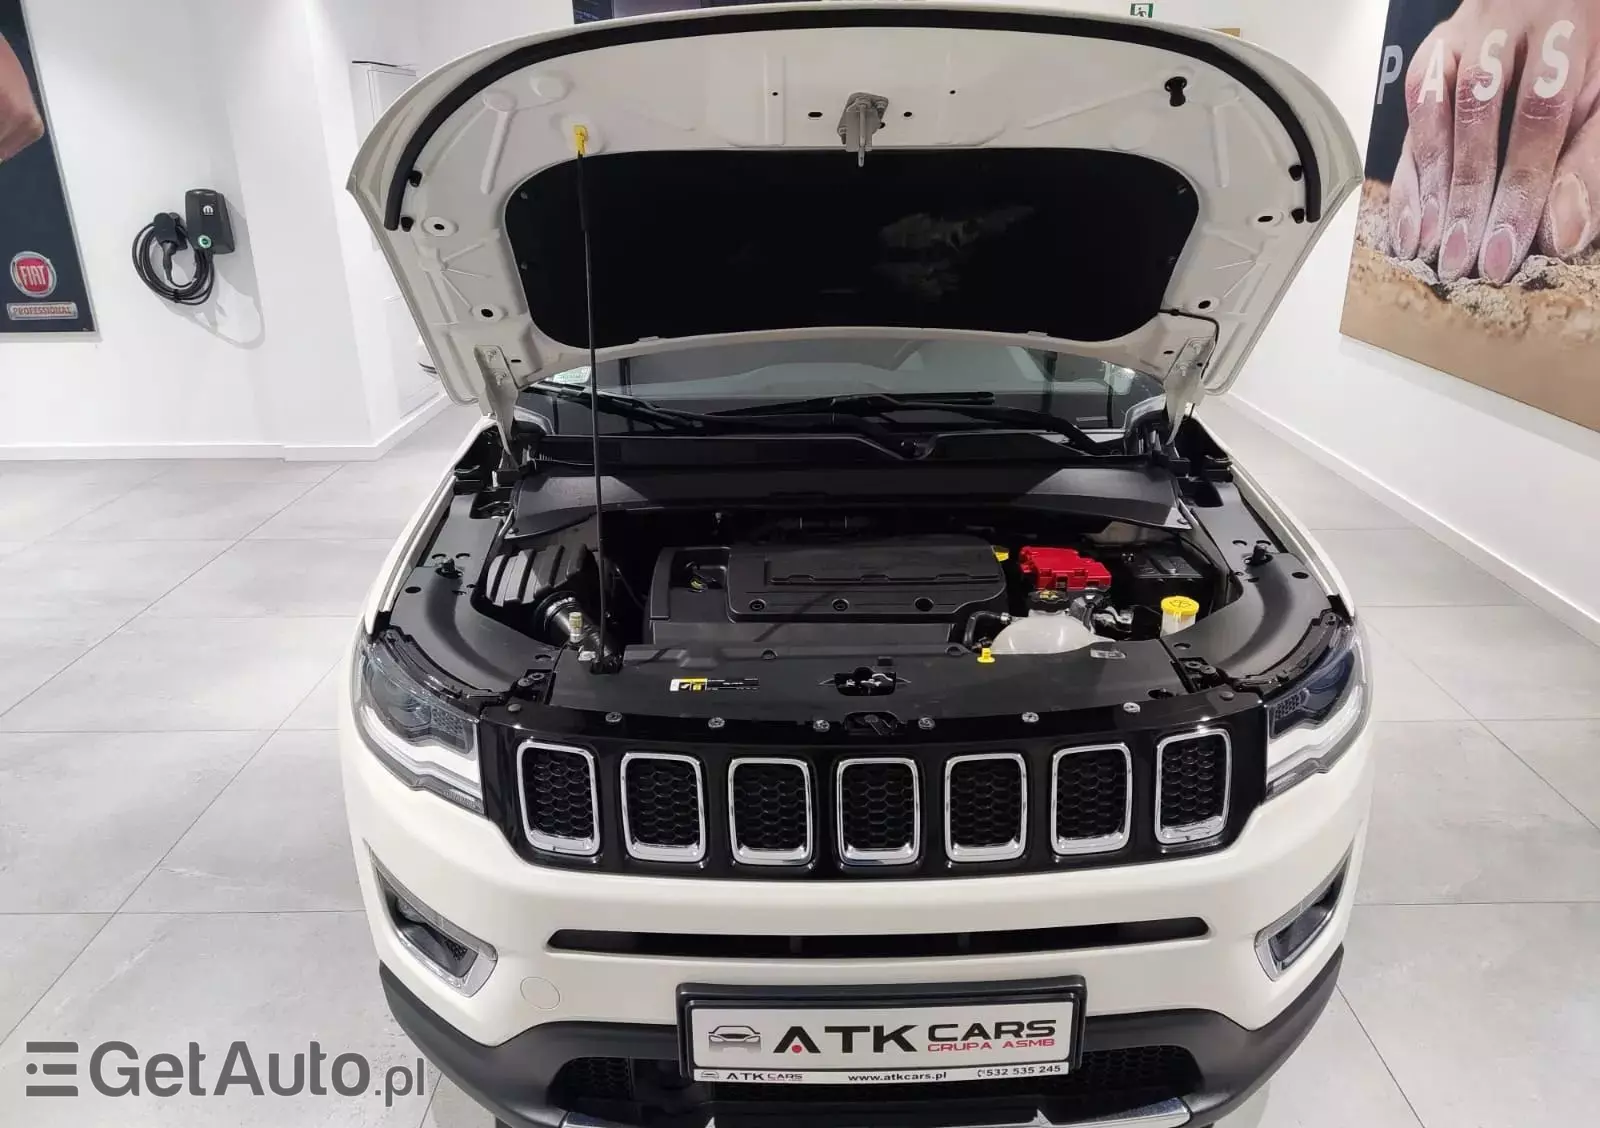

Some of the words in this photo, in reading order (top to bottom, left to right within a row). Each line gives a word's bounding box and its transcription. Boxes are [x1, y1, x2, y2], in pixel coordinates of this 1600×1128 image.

[19, 265, 47, 287] FIAT
[13, 306, 73, 316] PROFESSIONAL
[772, 1024, 919, 1054] ATK
[927, 1019, 1057, 1043] CARS
[927, 1041, 993, 1053] GRUPA
[1001, 1038, 1056, 1050] ASMB
[726, 1072, 765, 1081] ATK
[767, 1073, 804, 1081] CARS
[847, 1071, 947, 1081] www.atkcars.pl
[986, 1068, 1009, 1077] 532
[1012, 1066, 1035, 1076] 535
[1039, 1064, 1061, 1074] 245
